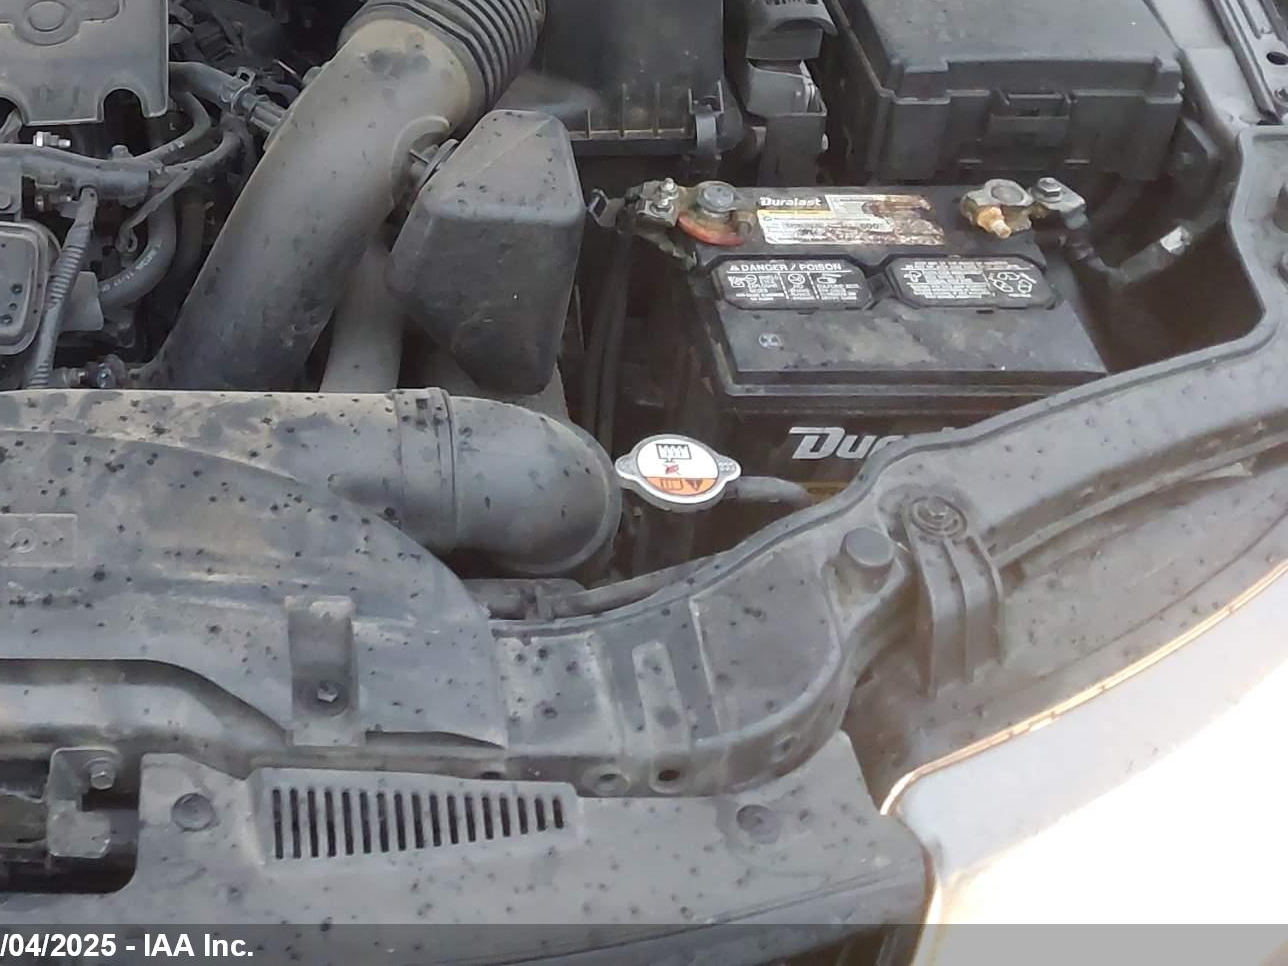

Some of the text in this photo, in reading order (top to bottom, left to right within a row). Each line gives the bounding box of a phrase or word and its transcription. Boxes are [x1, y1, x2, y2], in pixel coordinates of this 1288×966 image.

[759, 196, 822, 207] Duralast
[740, 263, 788, 272] DANGER
[798, 262, 842, 271] POISON
